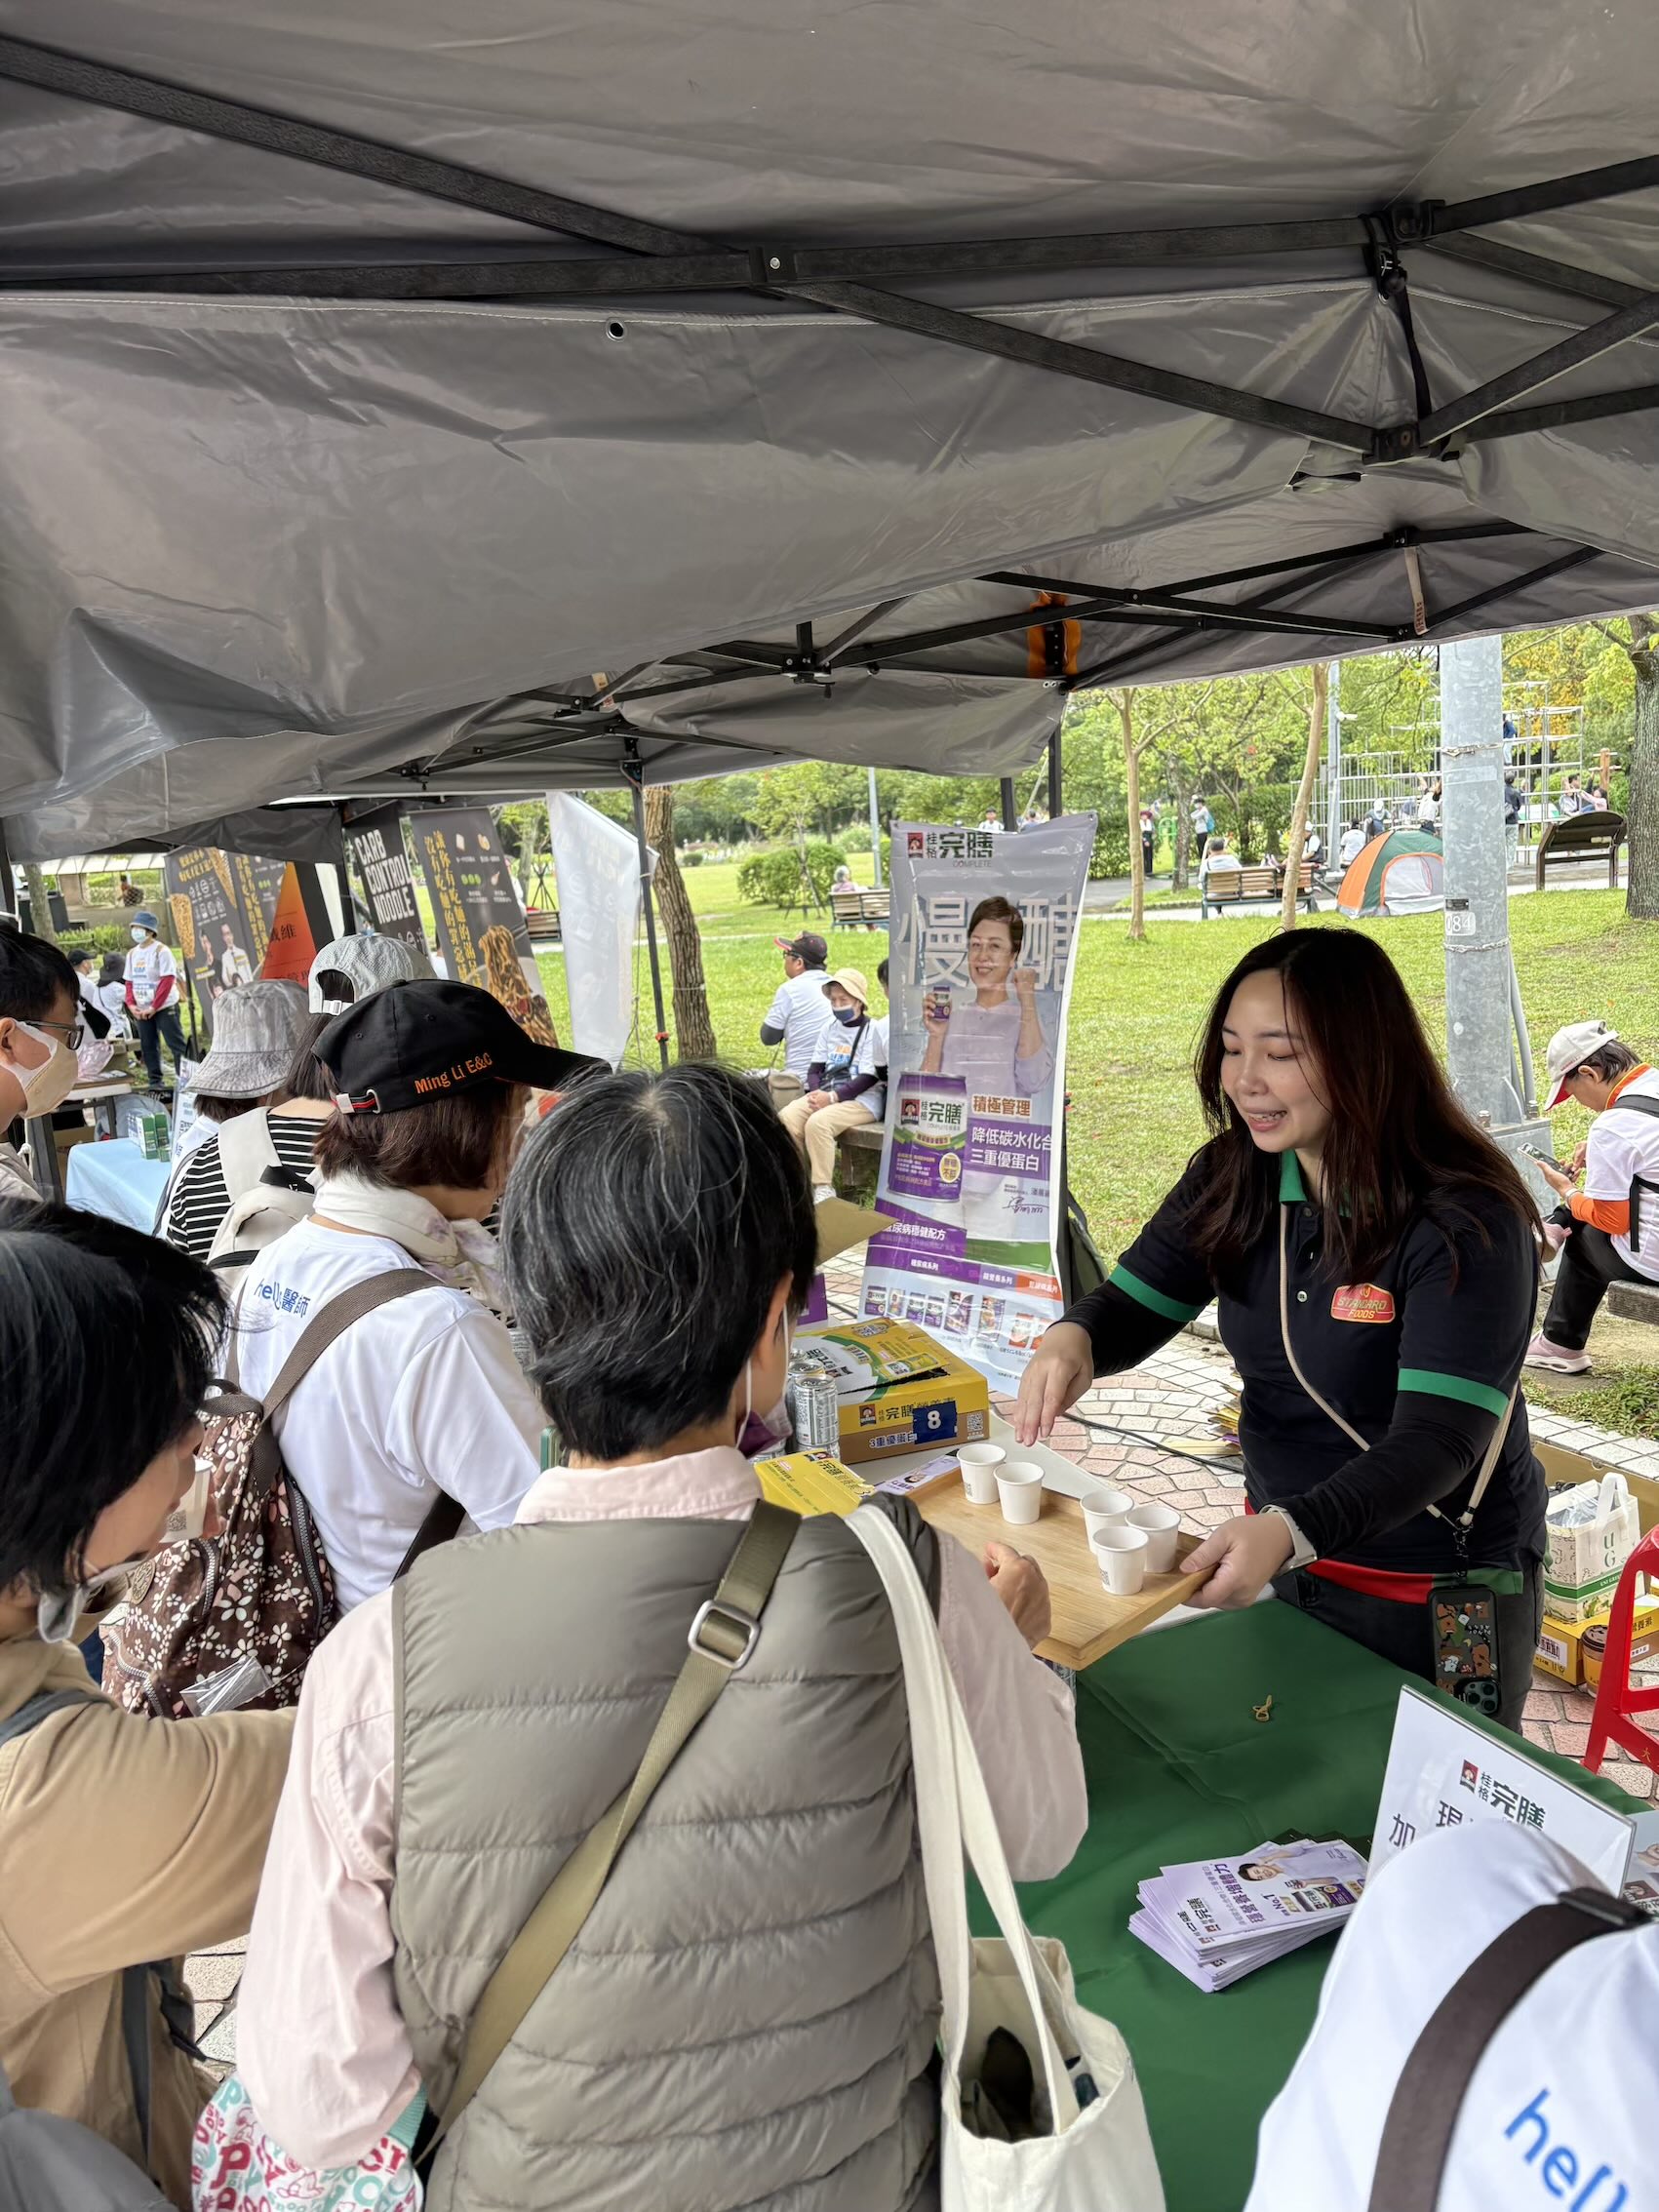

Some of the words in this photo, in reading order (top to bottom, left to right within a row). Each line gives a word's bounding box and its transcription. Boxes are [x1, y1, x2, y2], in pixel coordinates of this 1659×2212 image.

[354, 829, 387, 866] CARB
[938, 832, 994, 859] 完膳
[372, 886, 415, 926] NOODLE
[415, 1071, 449, 1094] Ming
[452, 1063, 465, 1081] Li
[467, 1052, 494, 1074] E&C
[928, 1101, 963, 1125] 完膳
[972, 1095, 1031, 1117] 積極管理
[969, 1148, 1040, 1171] 三重優蛋白
[1336, 1295, 1387, 1310] STANDARD
[1347, 1309, 1375, 1319] FOODS
[928, 1410, 942, 1430] 8
[1478, 1771, 1493, 1802] 桂格
[1490, 1779, 1548, 1832] 完膳
[1389, 1813, 1416, 1850] 加
[1262, 1893, 1284, 1911] No.1
